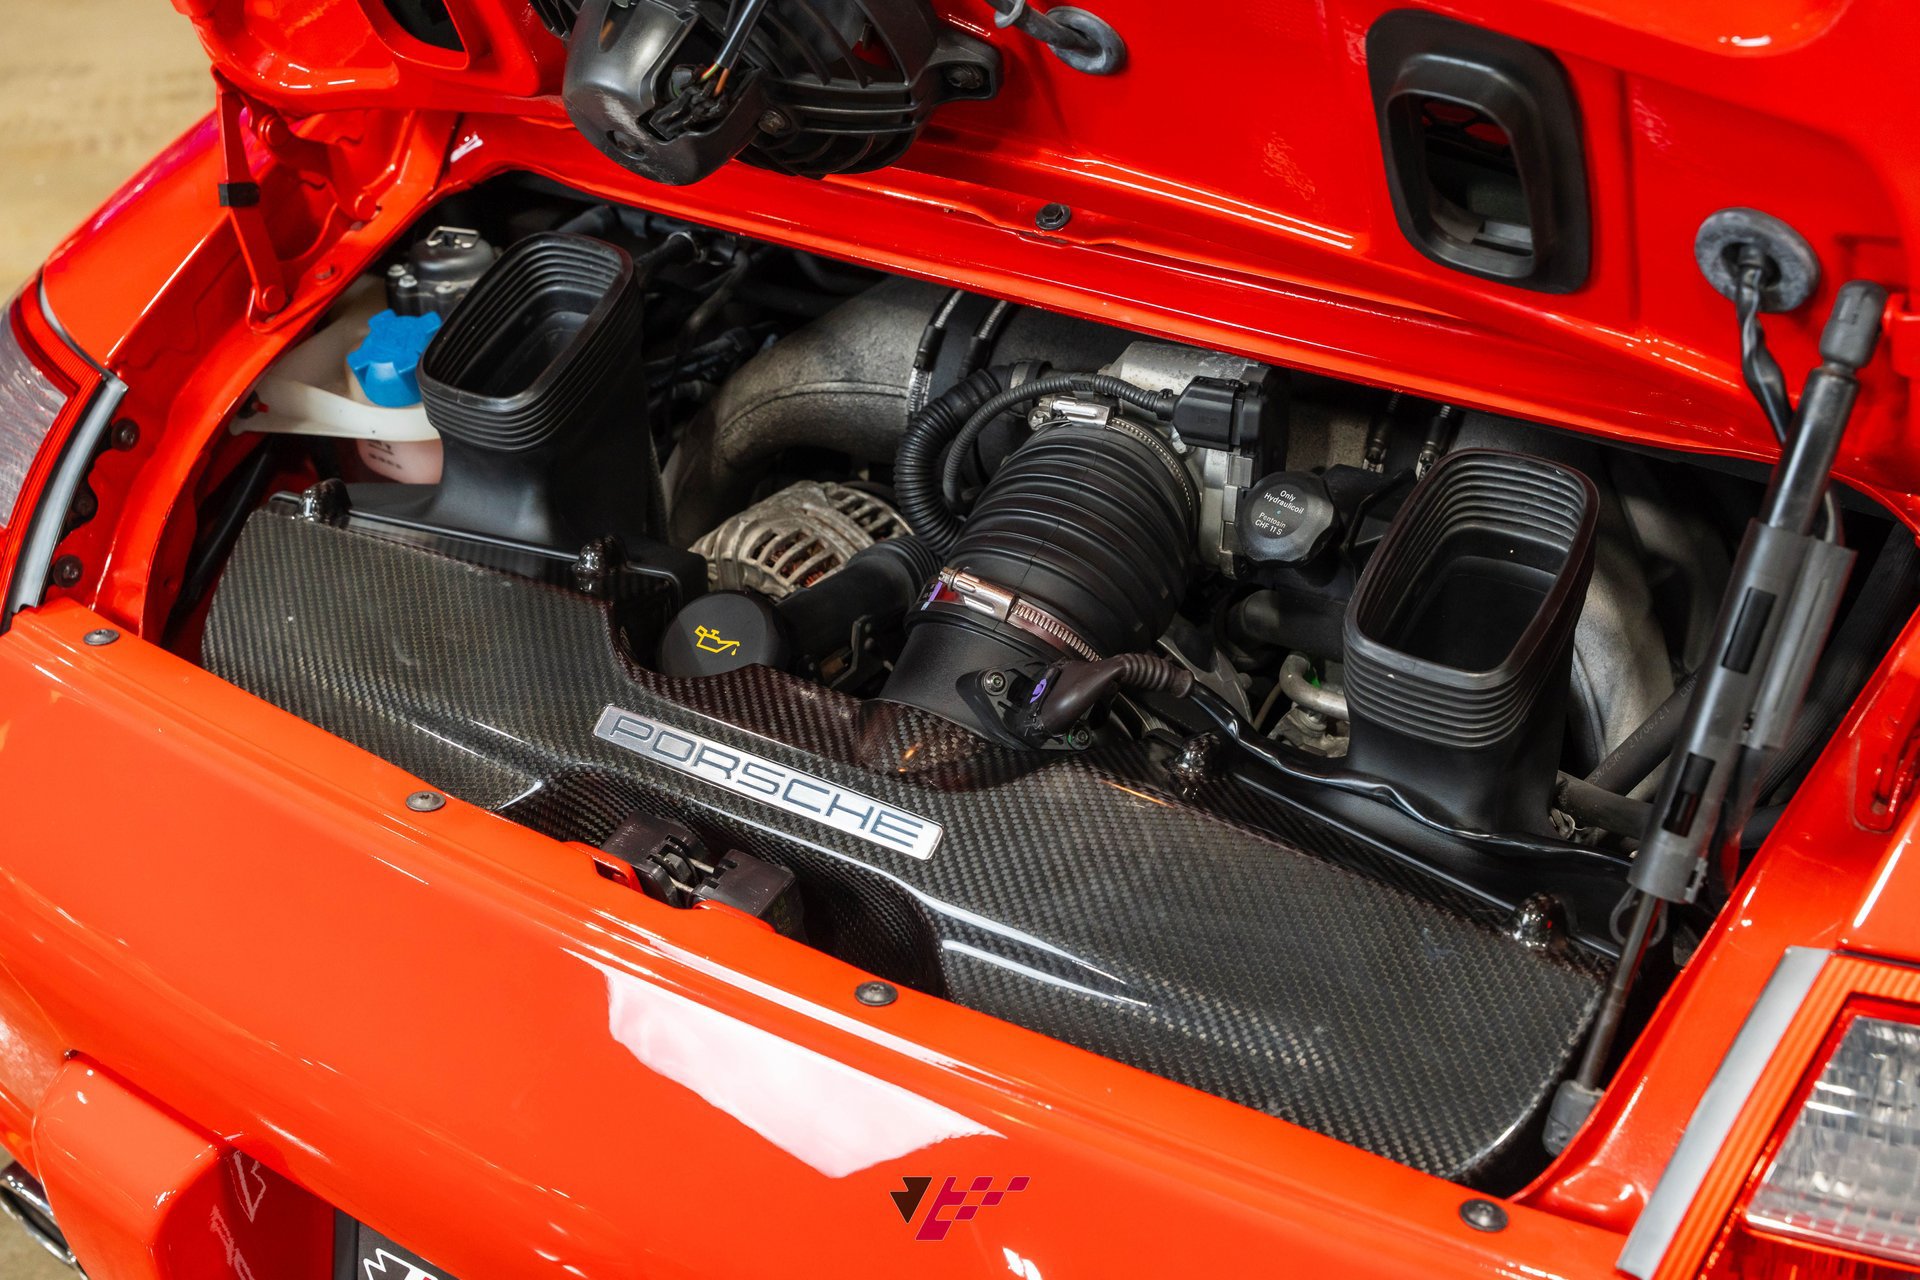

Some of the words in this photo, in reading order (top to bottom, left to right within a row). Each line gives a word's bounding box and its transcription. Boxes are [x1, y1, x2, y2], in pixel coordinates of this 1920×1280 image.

[1263, 492, 1305, 514] Hydraulicoil
[1280, 490, 1296, 502] Only
[1255, 519, 1270, 529] CHF
[1269, 525, 1277, 533] 11
[1276, 528, 1283, 536] S
[1258, 512, 1286, 528] Pentosin
[609, 714, 924, 849] PORSCHE
